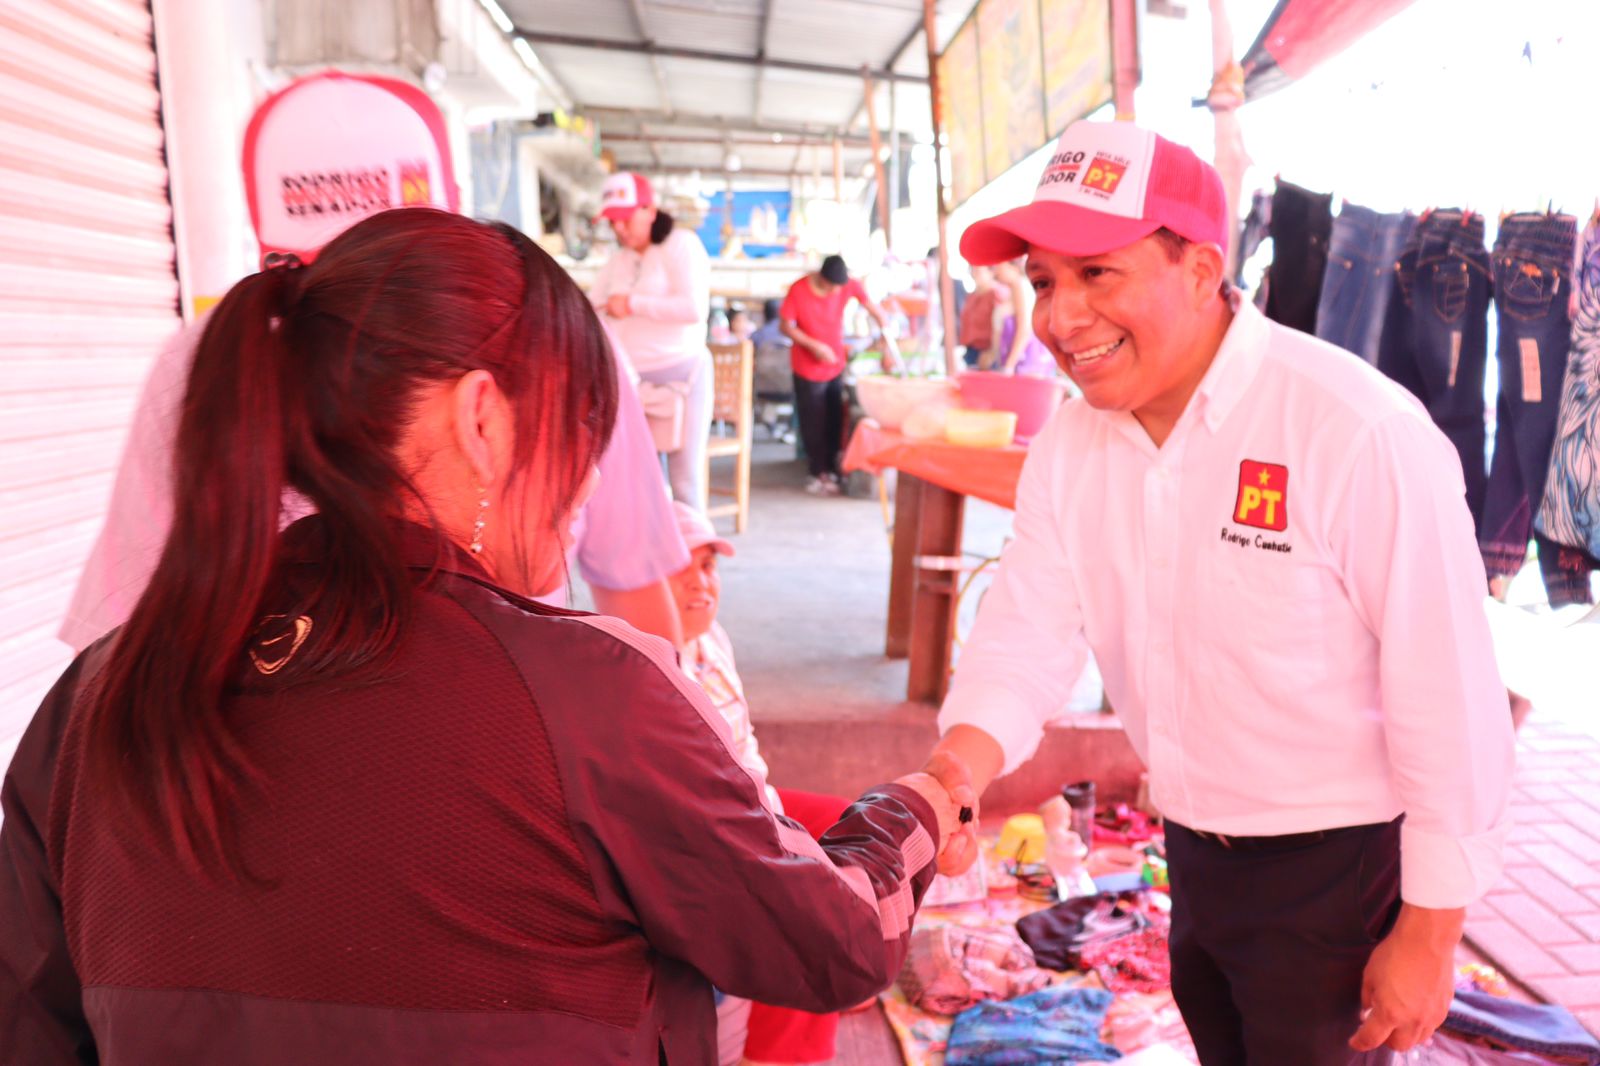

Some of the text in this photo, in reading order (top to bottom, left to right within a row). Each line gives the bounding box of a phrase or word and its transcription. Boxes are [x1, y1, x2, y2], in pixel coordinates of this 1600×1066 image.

[1086, 168, 1118, 189] PT
[1238, 485, 1282, 525] PT
[1221, 527, 1251, 548] Rodrigo
